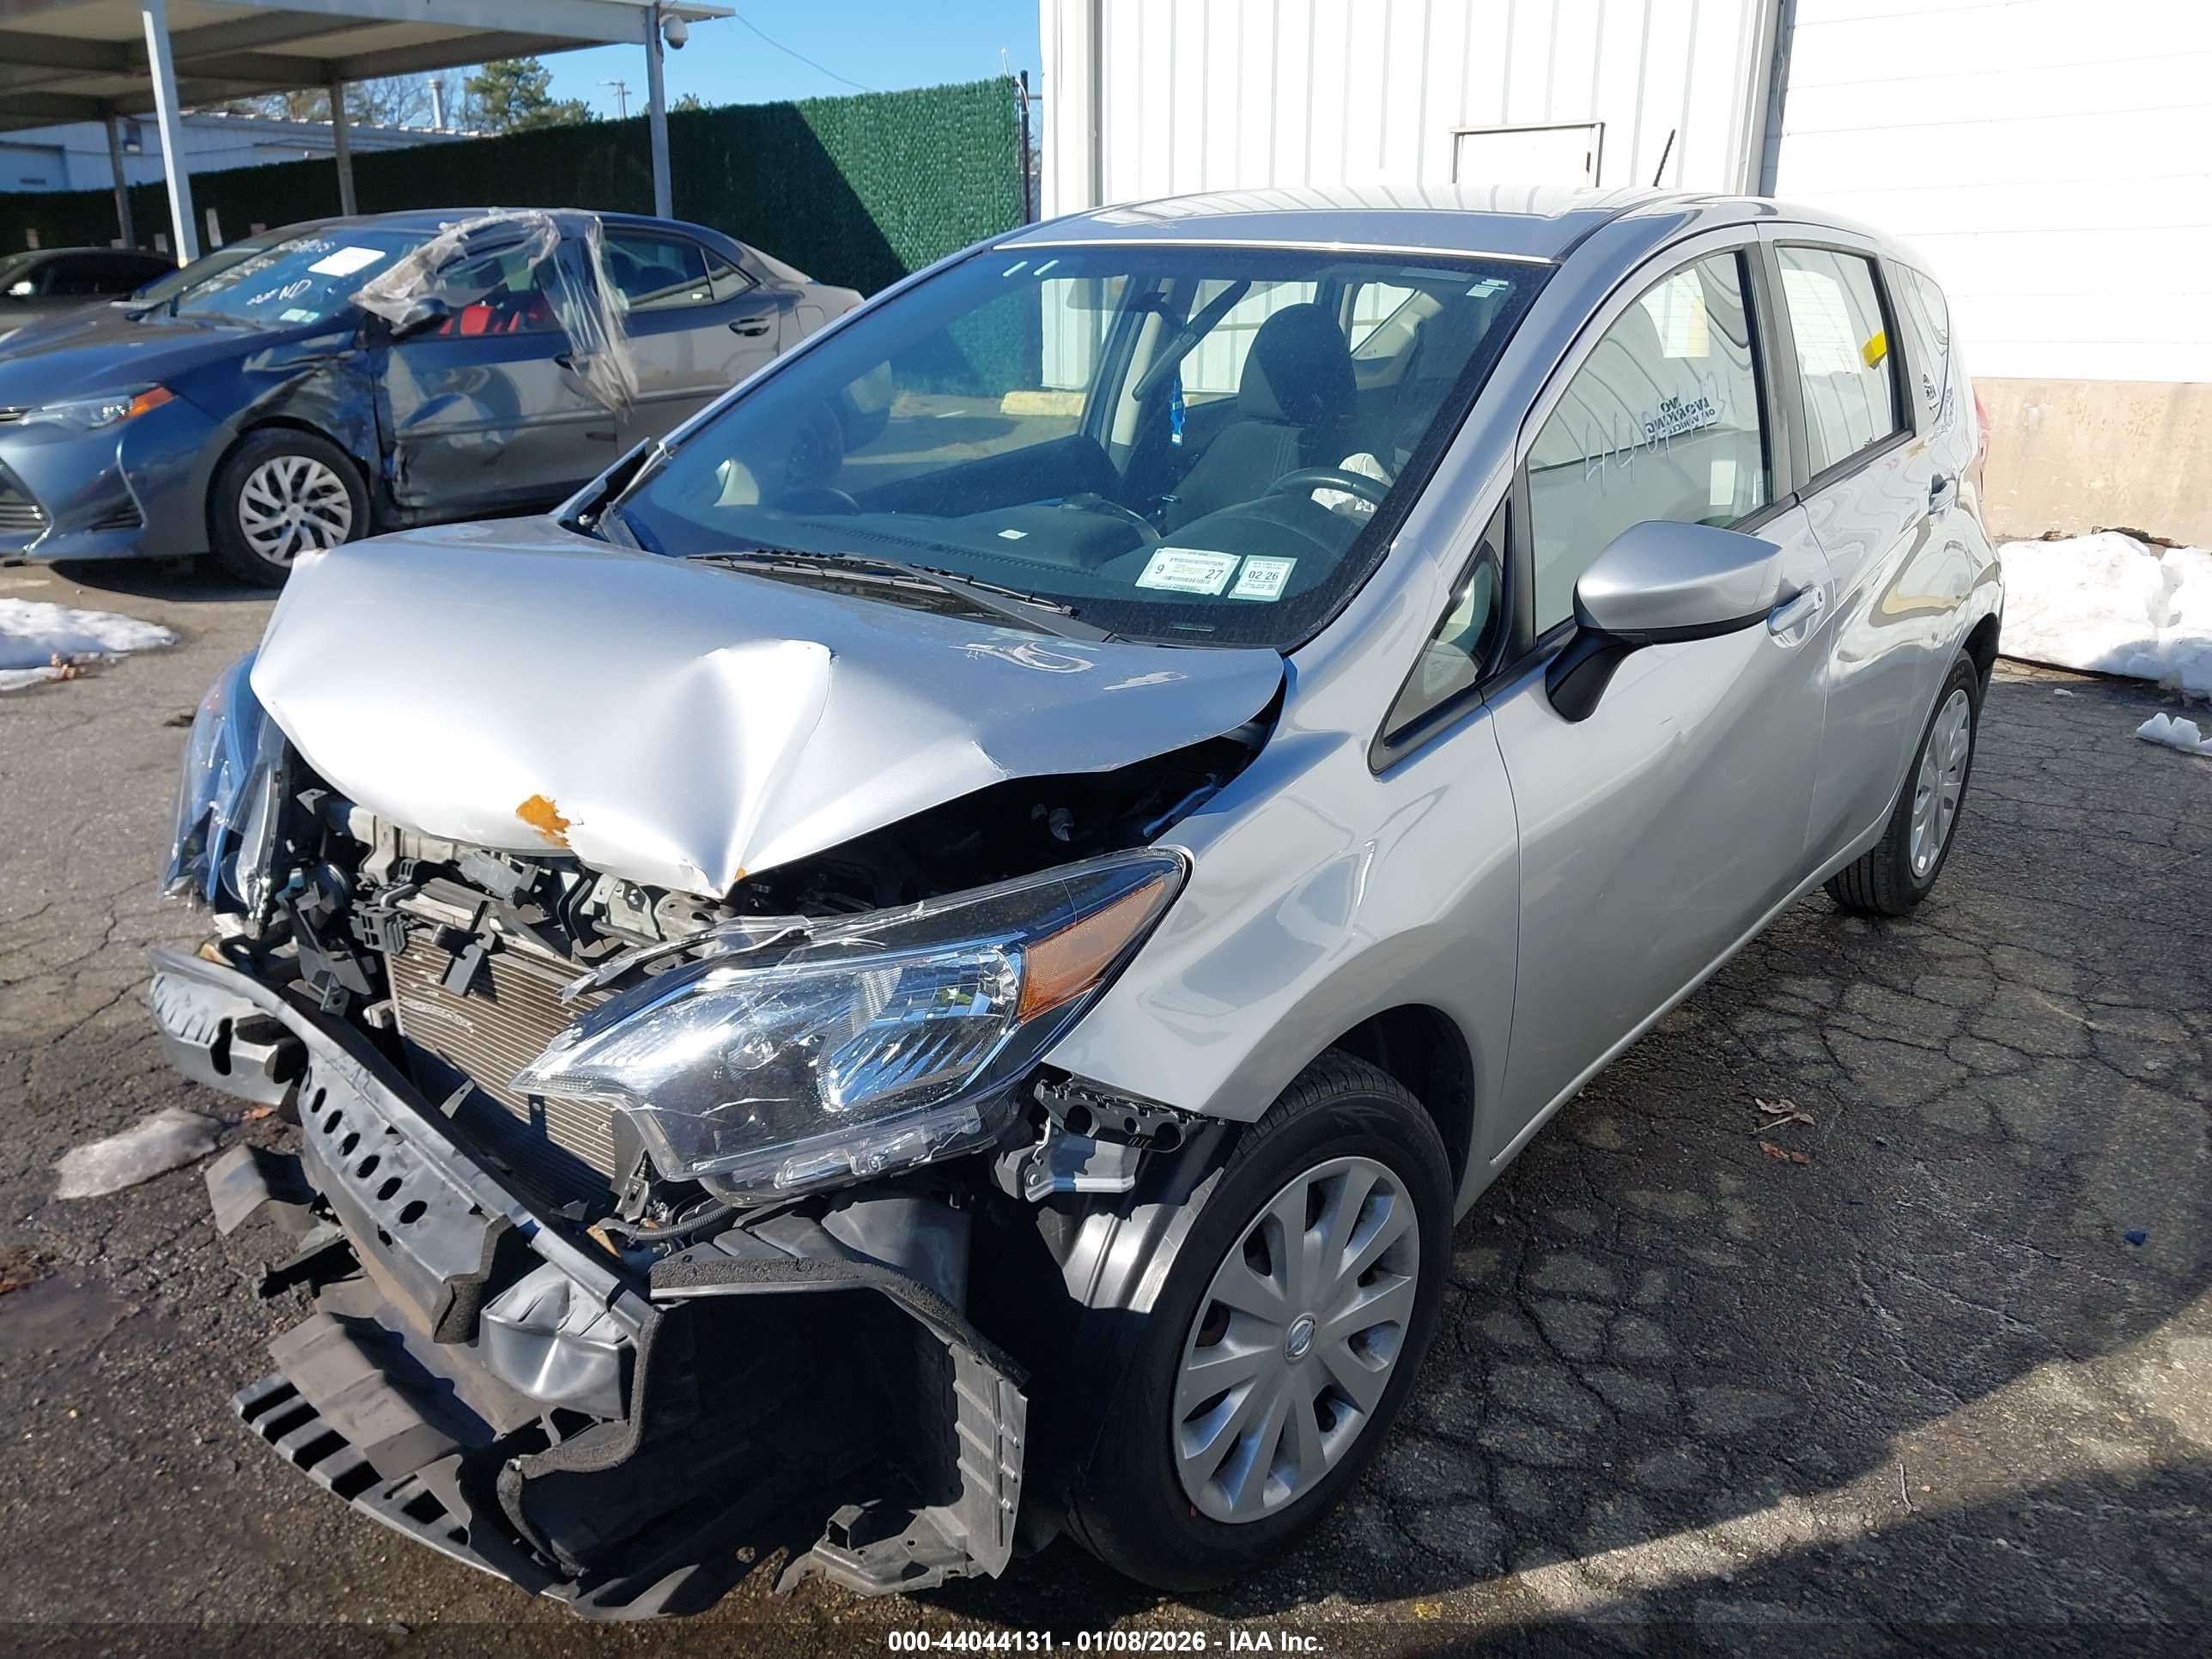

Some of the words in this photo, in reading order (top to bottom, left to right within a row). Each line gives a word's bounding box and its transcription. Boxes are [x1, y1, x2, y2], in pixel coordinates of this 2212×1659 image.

[1155, 564, 1165, 574] 9
[1206, 568, 1224, 580] 27
[1248, 570, 1263, 580] 02
